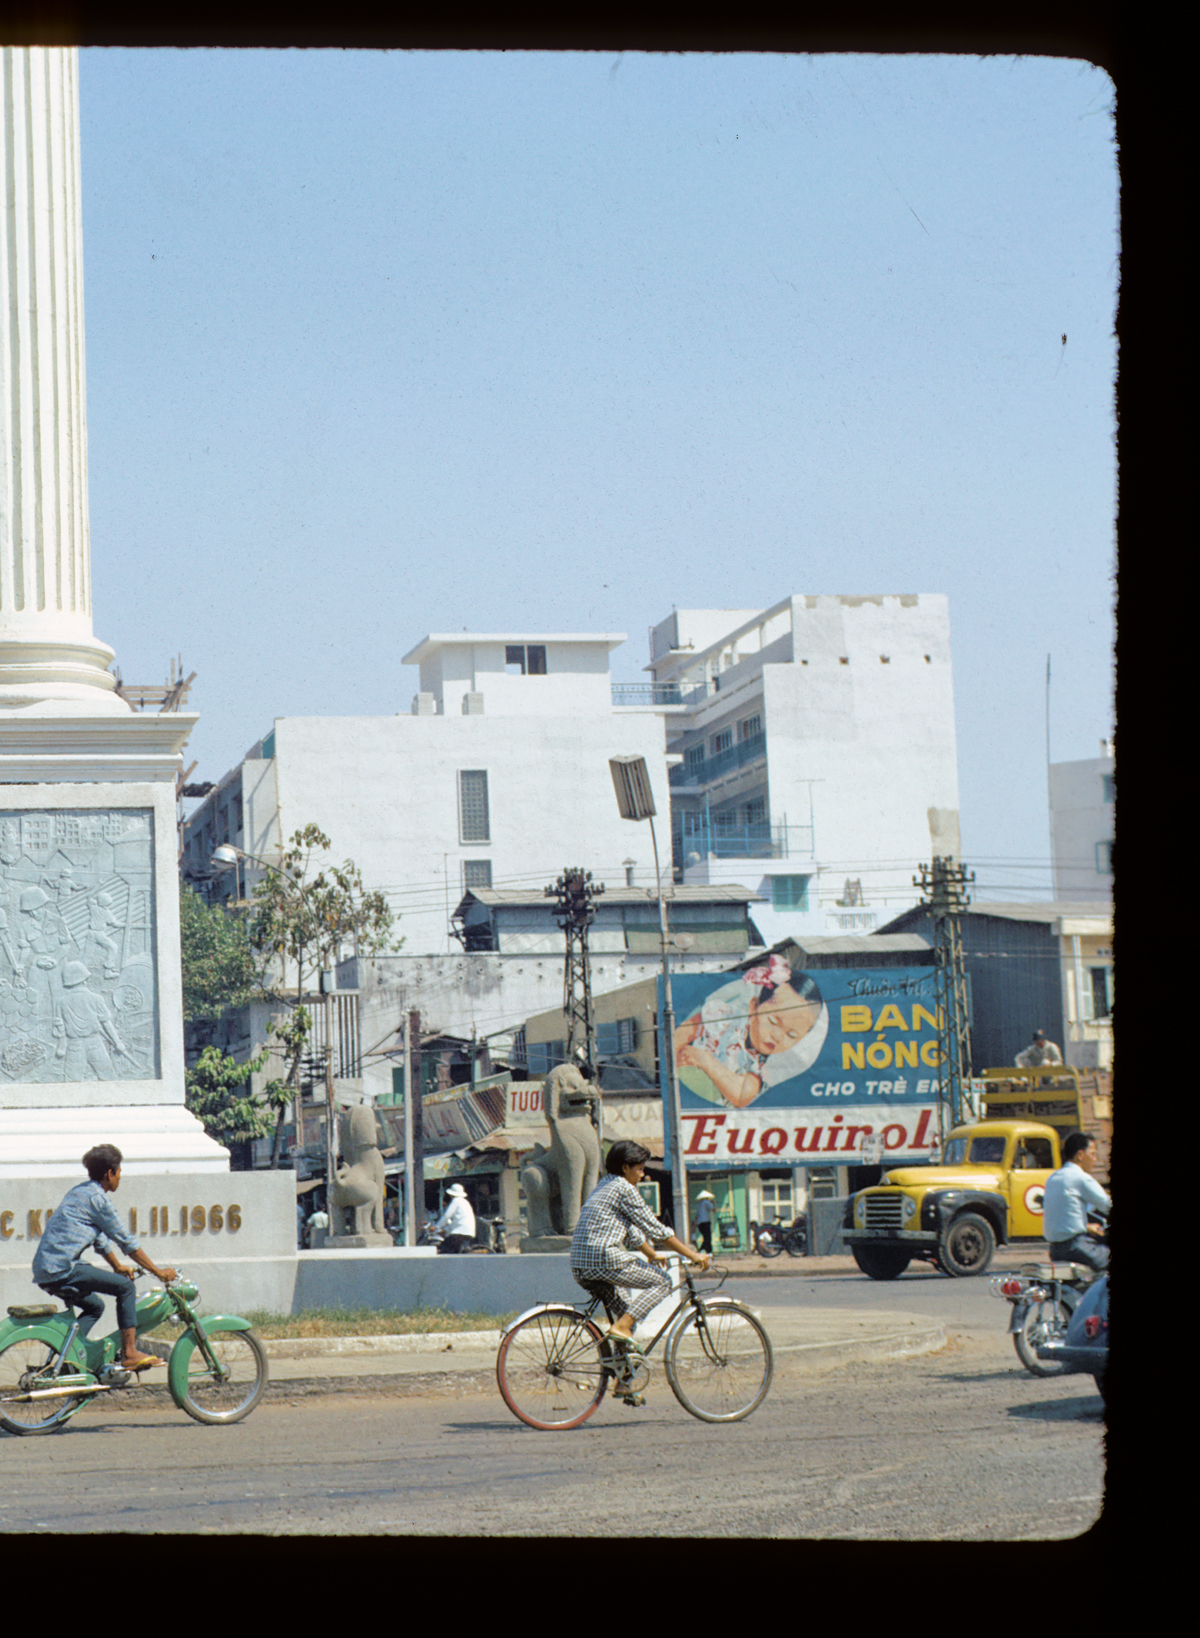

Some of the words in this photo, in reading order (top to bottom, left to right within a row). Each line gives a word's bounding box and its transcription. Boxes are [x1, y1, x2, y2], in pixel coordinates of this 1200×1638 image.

[841, 1004, 945, 1032] BAN
[842, 1034, 947, 1069] NÓNG
[811, 1081, 855, 1096] CHO
[866, 1076, 907, 1095] TRẺ
